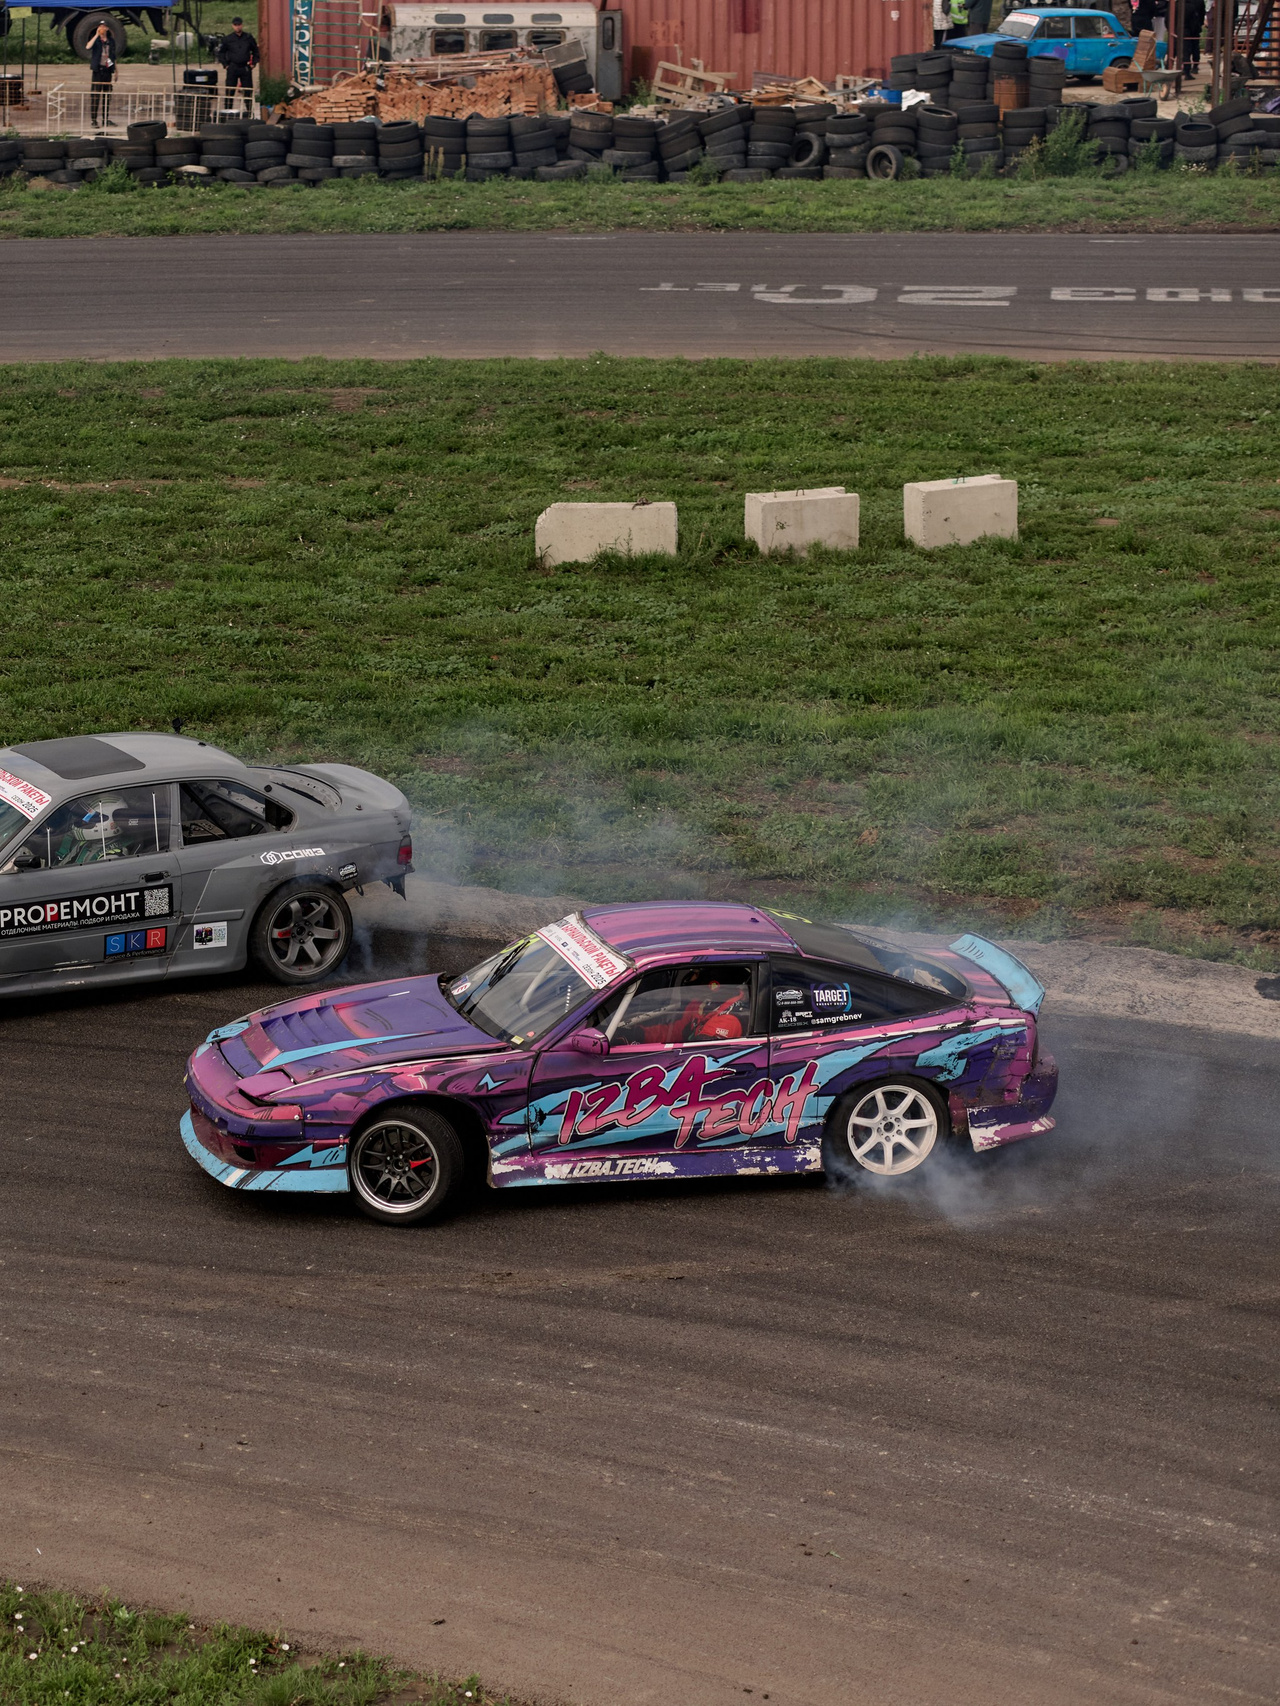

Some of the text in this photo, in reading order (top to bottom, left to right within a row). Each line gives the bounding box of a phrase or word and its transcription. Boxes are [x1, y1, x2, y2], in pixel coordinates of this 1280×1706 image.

[17, 783, 50, 806] РАКЕТЫ
[281, 847, 326, 860] СОЮЗ
[0, 924, 41, 936] ОТДЕЛОЧНЫЕ
[80, 916, 105, 925] ПОДБОР
[111, 911, 140, 921] ПРОДАЖА
[591, 952, 620, 977] РАКЕТЫ
[813, 989, 849, 1002] TARGET
[669, 1060, 820, 1149] TECH
